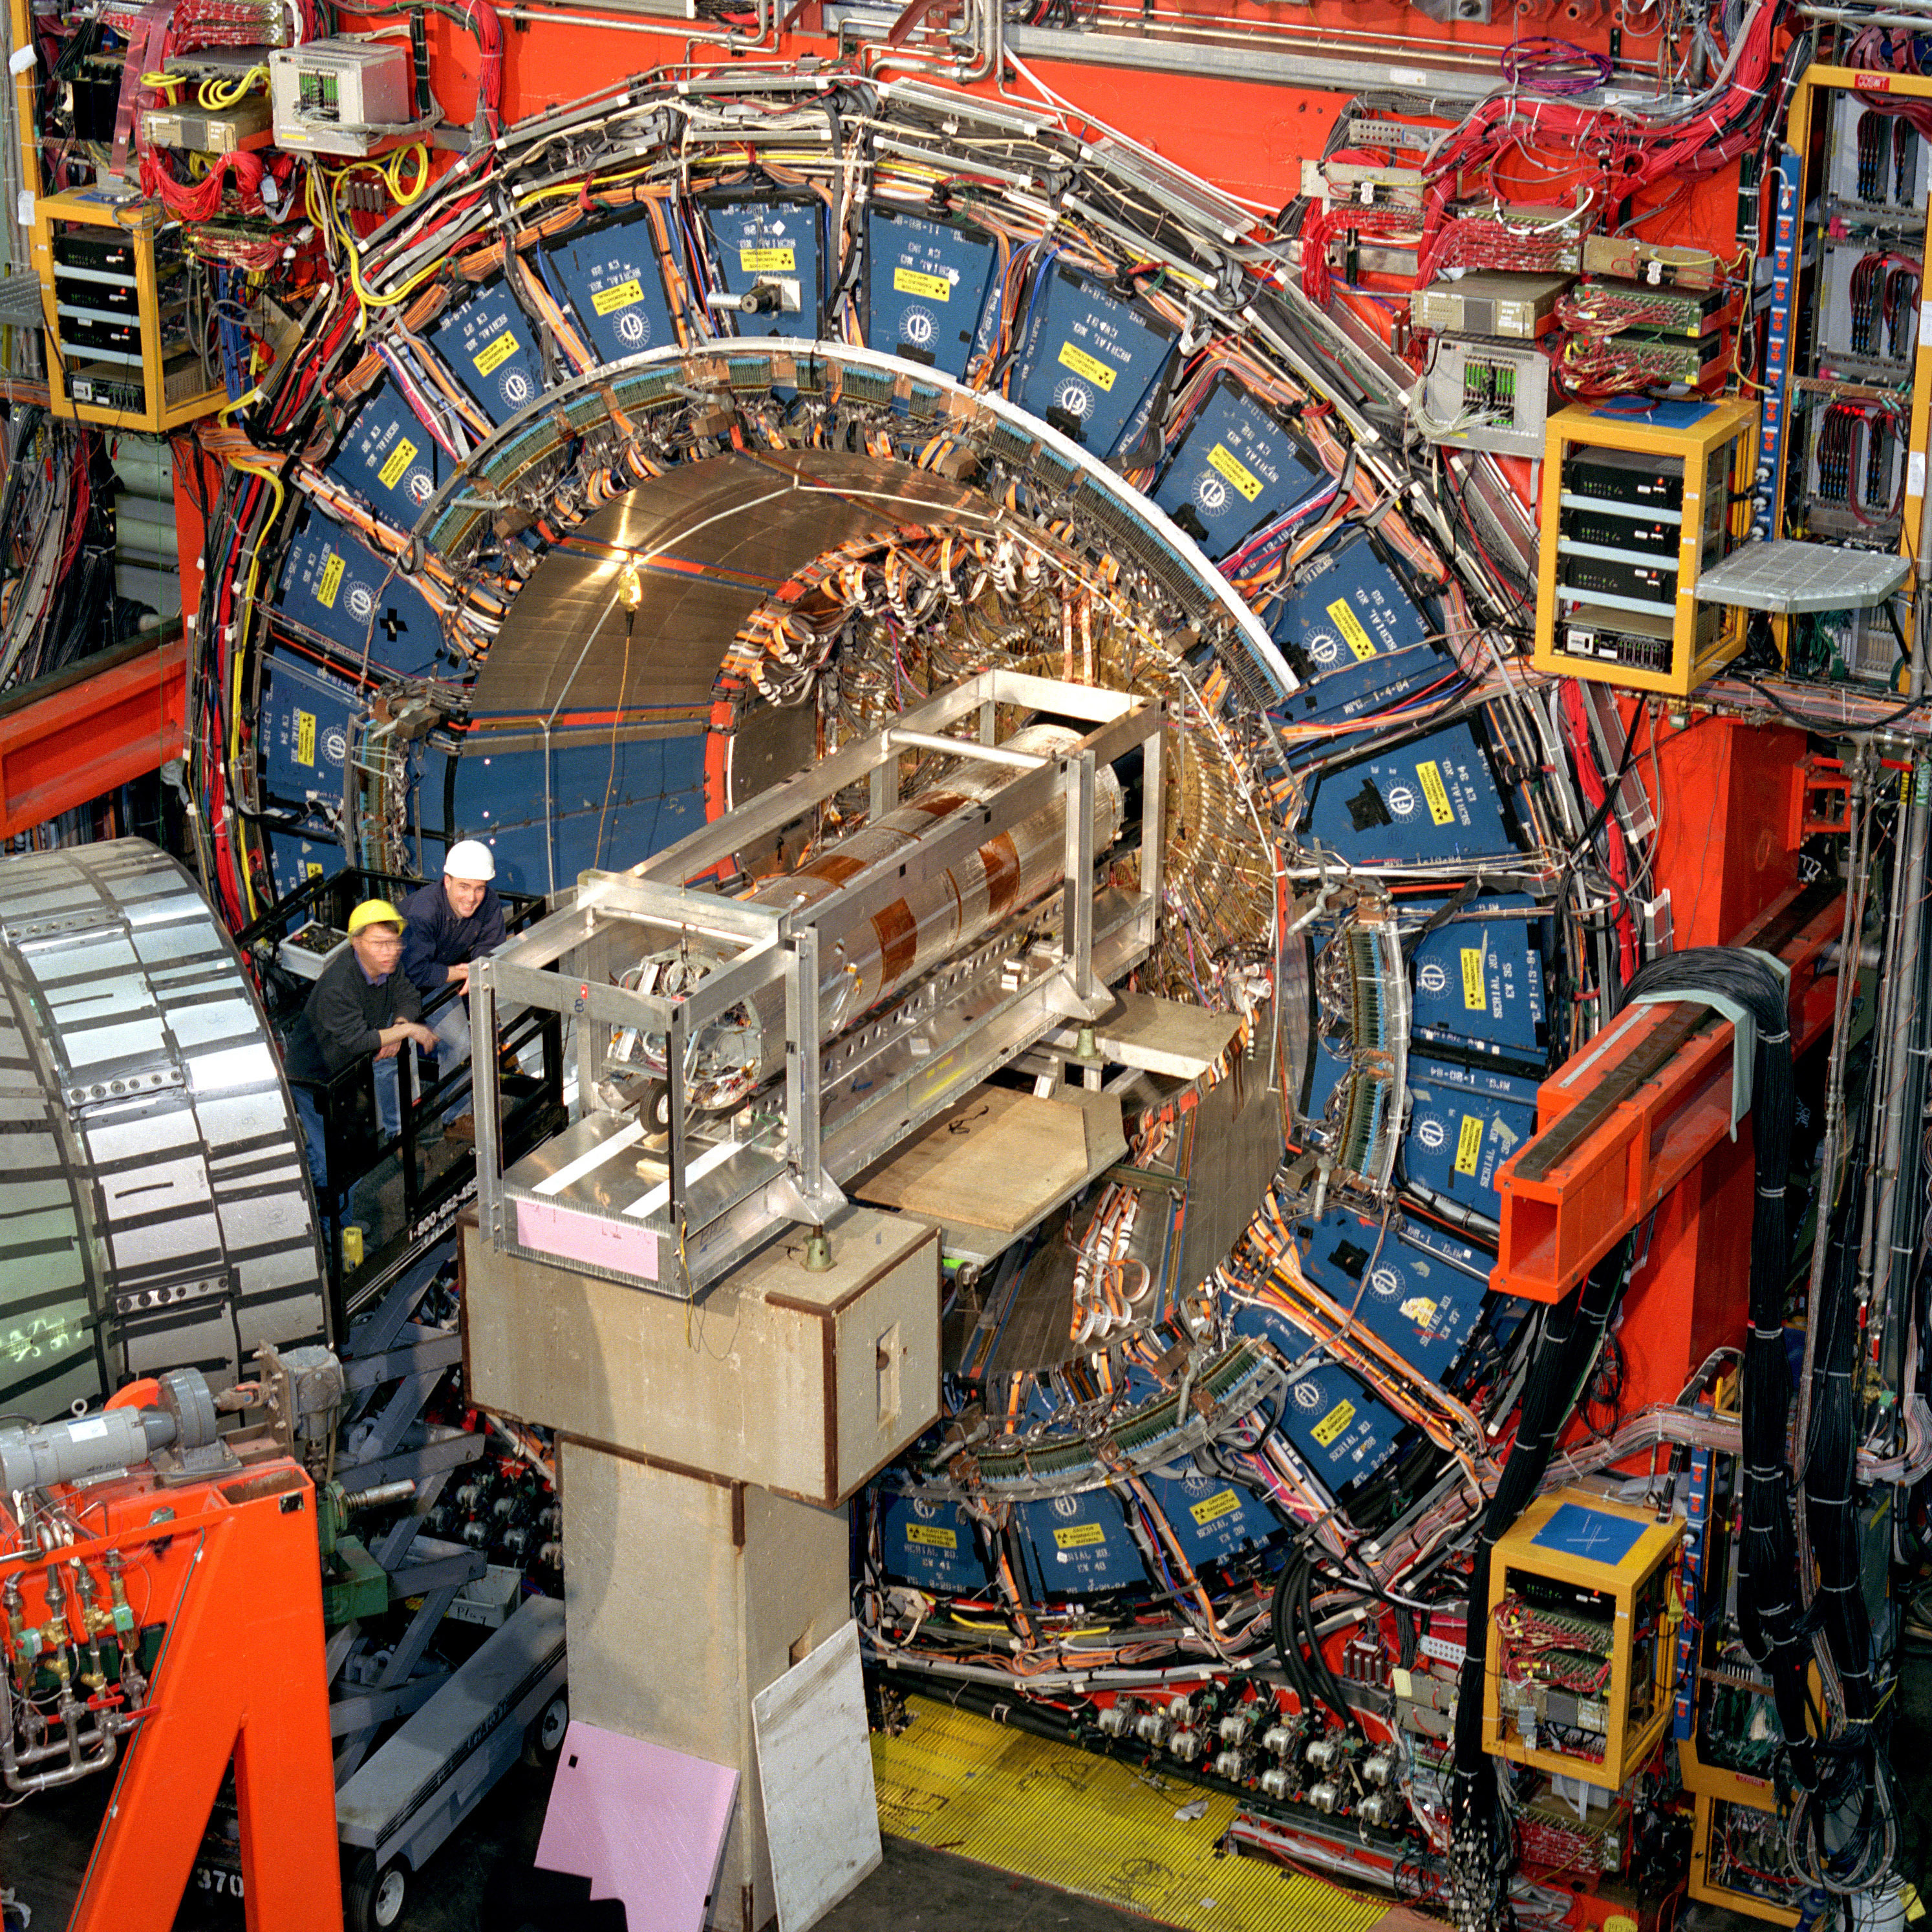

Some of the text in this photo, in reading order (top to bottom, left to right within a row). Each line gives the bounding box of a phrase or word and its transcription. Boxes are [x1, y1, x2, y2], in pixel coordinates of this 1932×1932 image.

[462, 321, 475, 336] 27
[1369, 588, 1386, 606] 33
[1456, 765, 1470, 781] 34
[1502, 961, 1512, 978] 35
[1447, 1309, 1461, 1325] 37
[197, 1867, 244, 1898] 370
